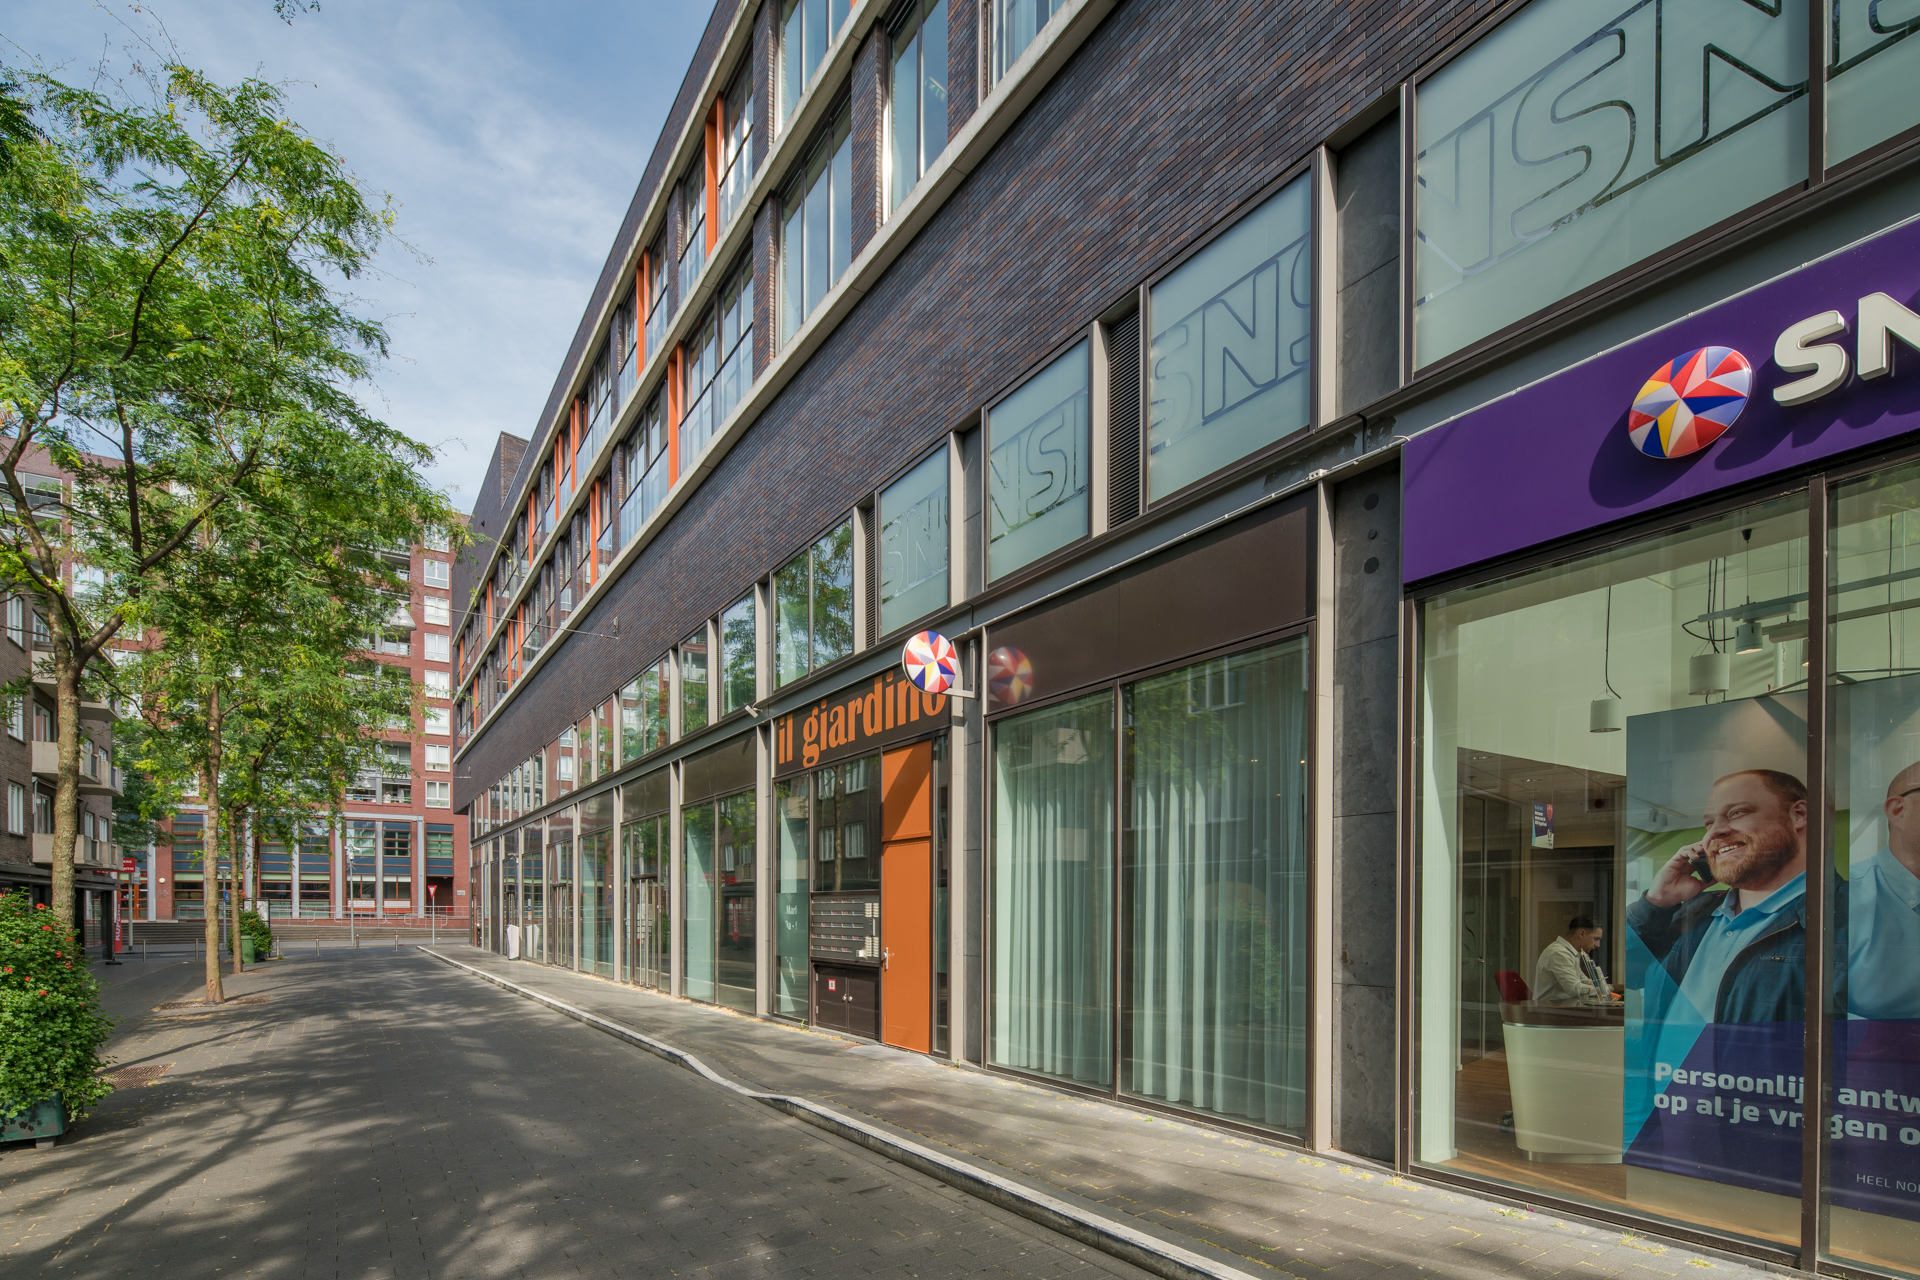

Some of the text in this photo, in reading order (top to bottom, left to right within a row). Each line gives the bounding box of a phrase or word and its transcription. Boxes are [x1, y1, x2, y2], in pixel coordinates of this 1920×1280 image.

[778, 670, 947, 768] il giardino
[1654, 1093, 1688, 1115] op
[1696, 1096, 1723, 1117] al
[1730, 1098, 1759, 1124] je
[1769, 1108, 1887, 1141] vrgen
[1856, 1173, 1920, 1193] HEEL NO
